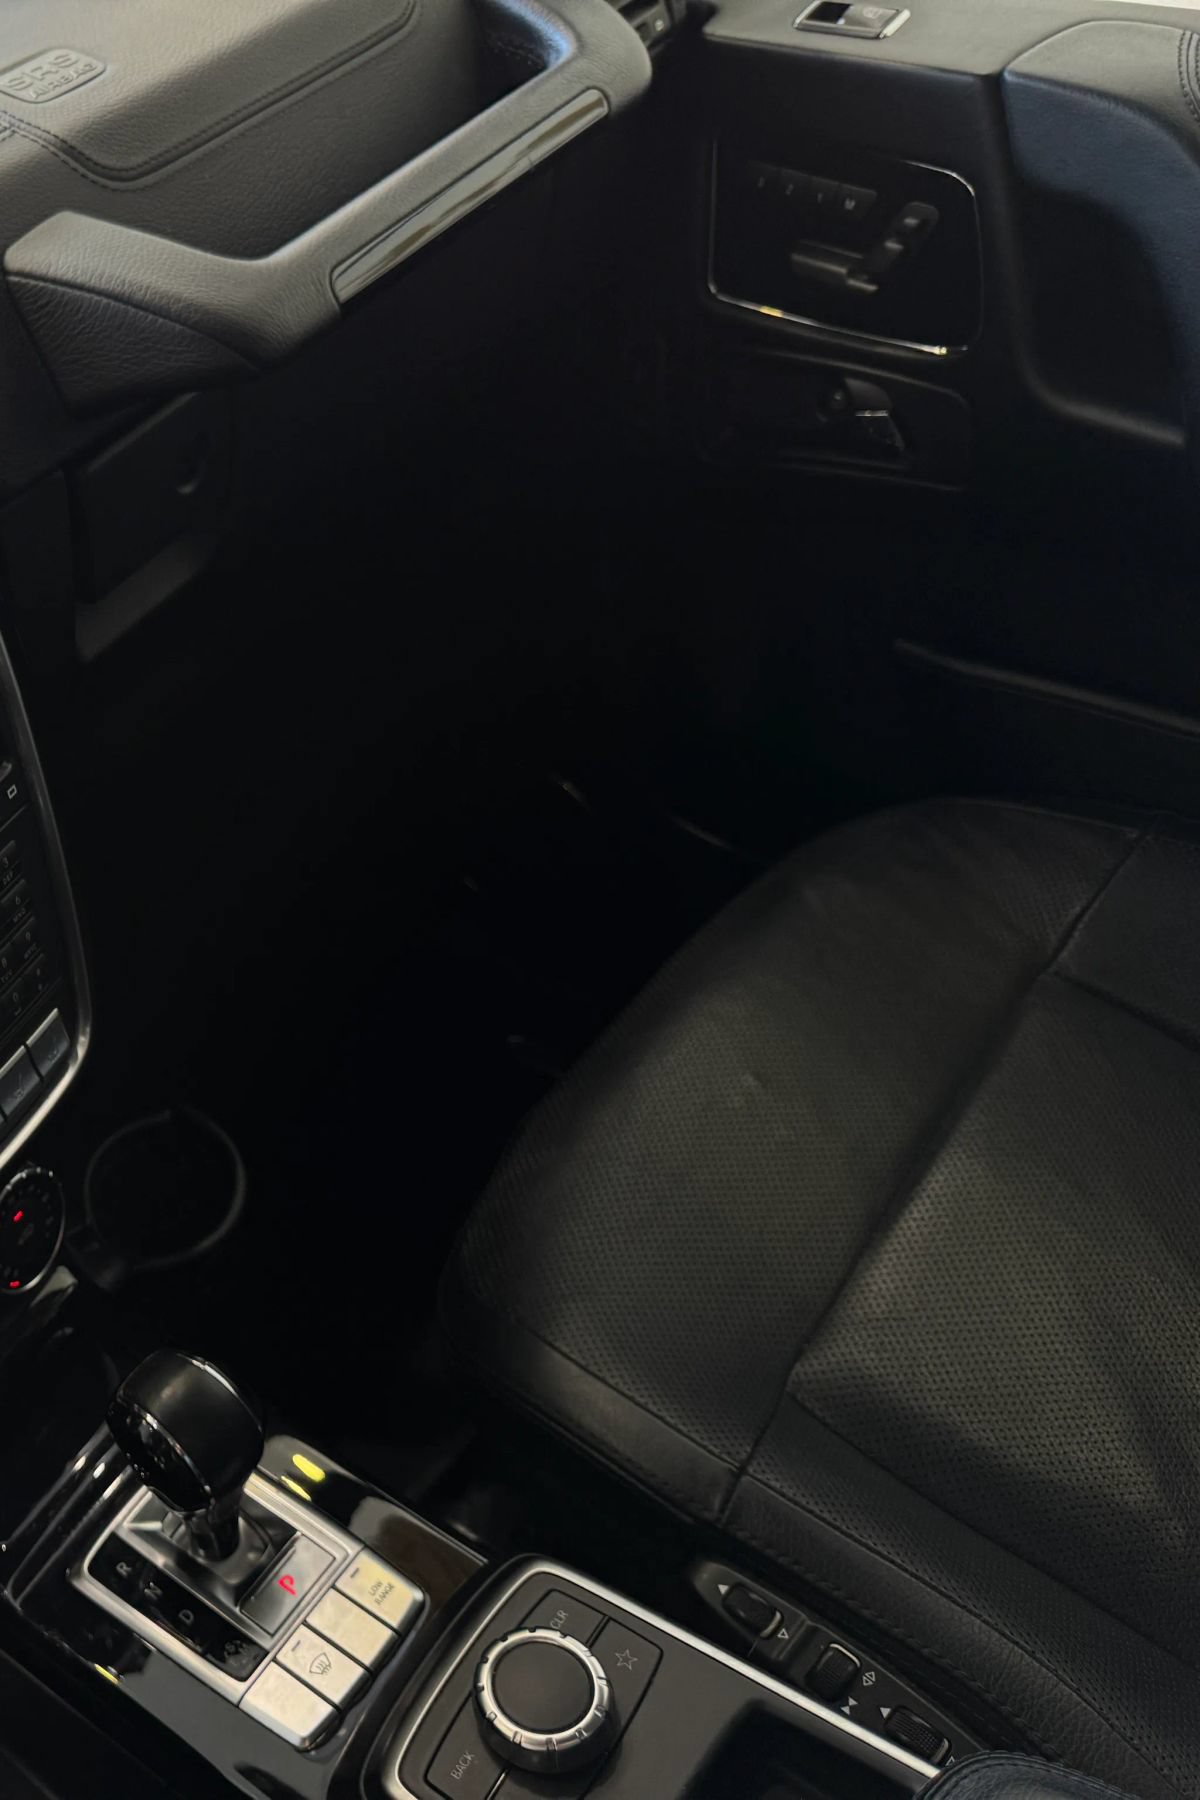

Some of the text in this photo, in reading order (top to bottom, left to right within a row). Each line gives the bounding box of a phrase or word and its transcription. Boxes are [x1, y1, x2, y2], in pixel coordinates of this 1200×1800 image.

[4, 54, 80, 91] SRS
[116, 1562, 132, 1578] R
[144, 1582, 163, 1600] N
[278, 1574, 297, 1595] P
[178, 1610, 194, 1626] D
[550, 1610, 568, 1630] CLR
[450, 1752, 475, 1780] BACK
